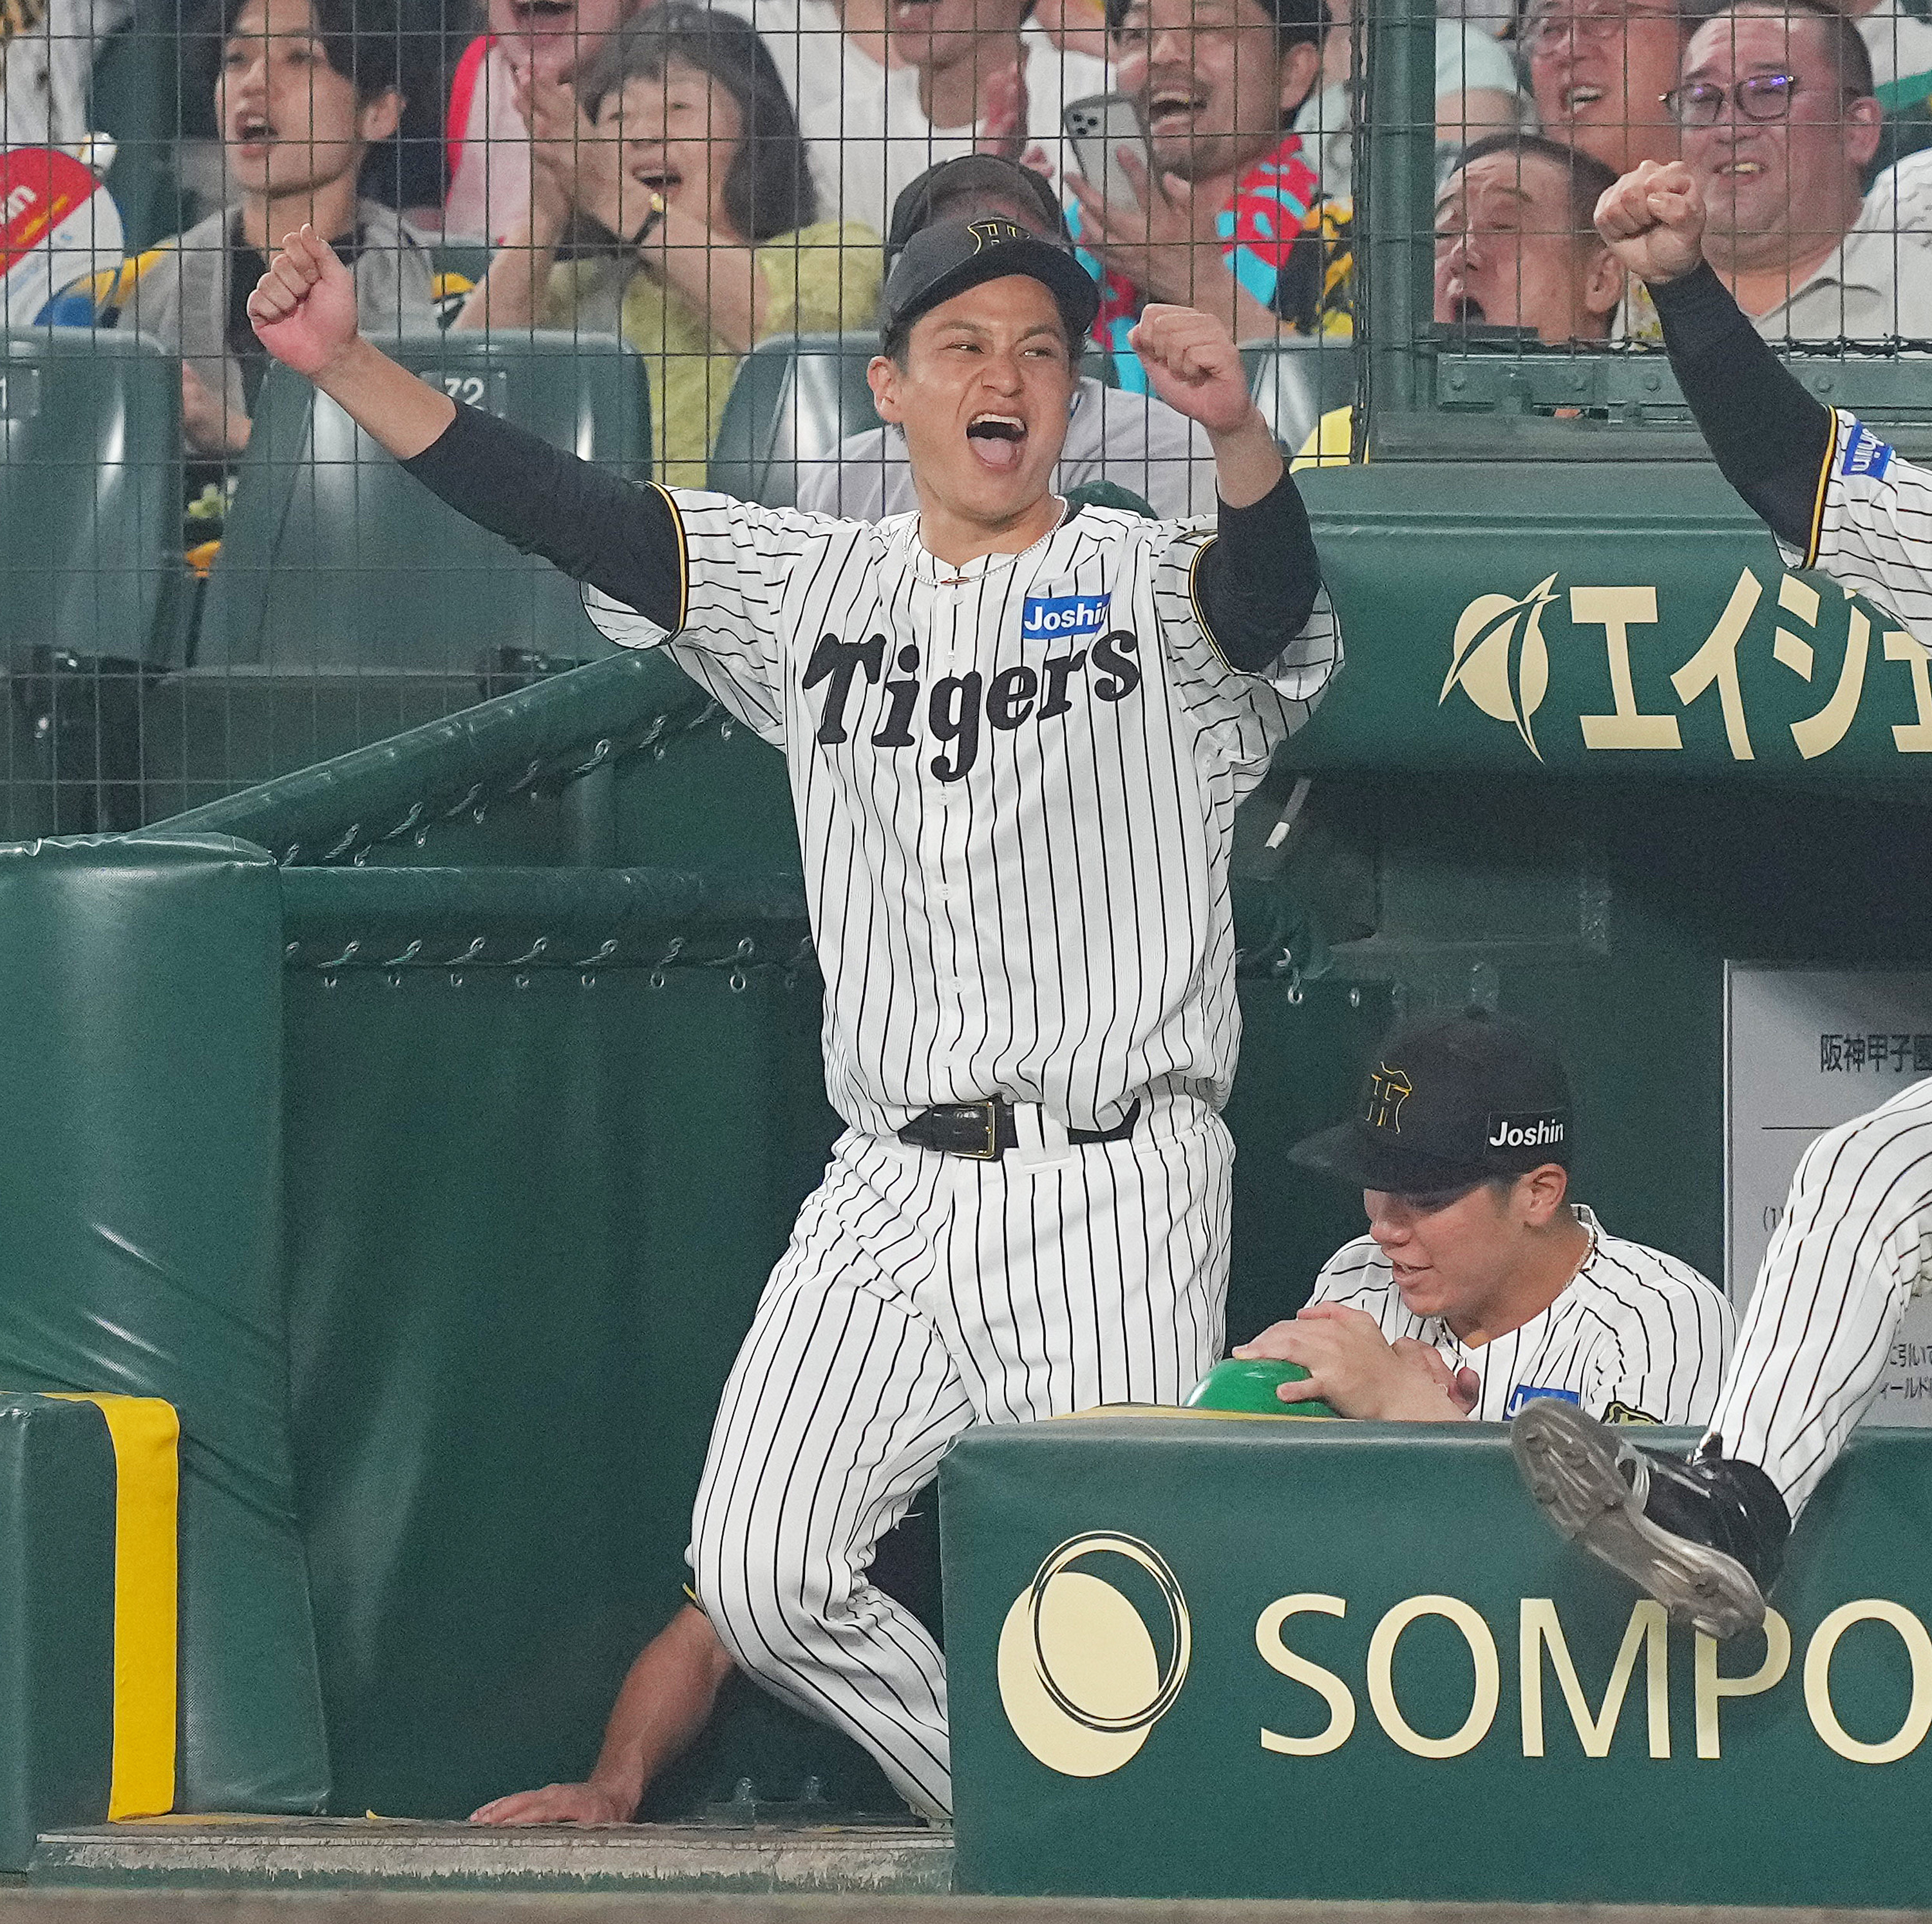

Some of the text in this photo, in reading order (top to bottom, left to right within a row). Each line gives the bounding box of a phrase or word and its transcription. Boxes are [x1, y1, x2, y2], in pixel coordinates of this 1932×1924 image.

[444, 377, 484, 411] 72
[802, 629, 1141, 782] Tigers
[1489, 1118, 1564, 1147] Joshin
[1254, 1592, 1932, 1764] SOMPO
